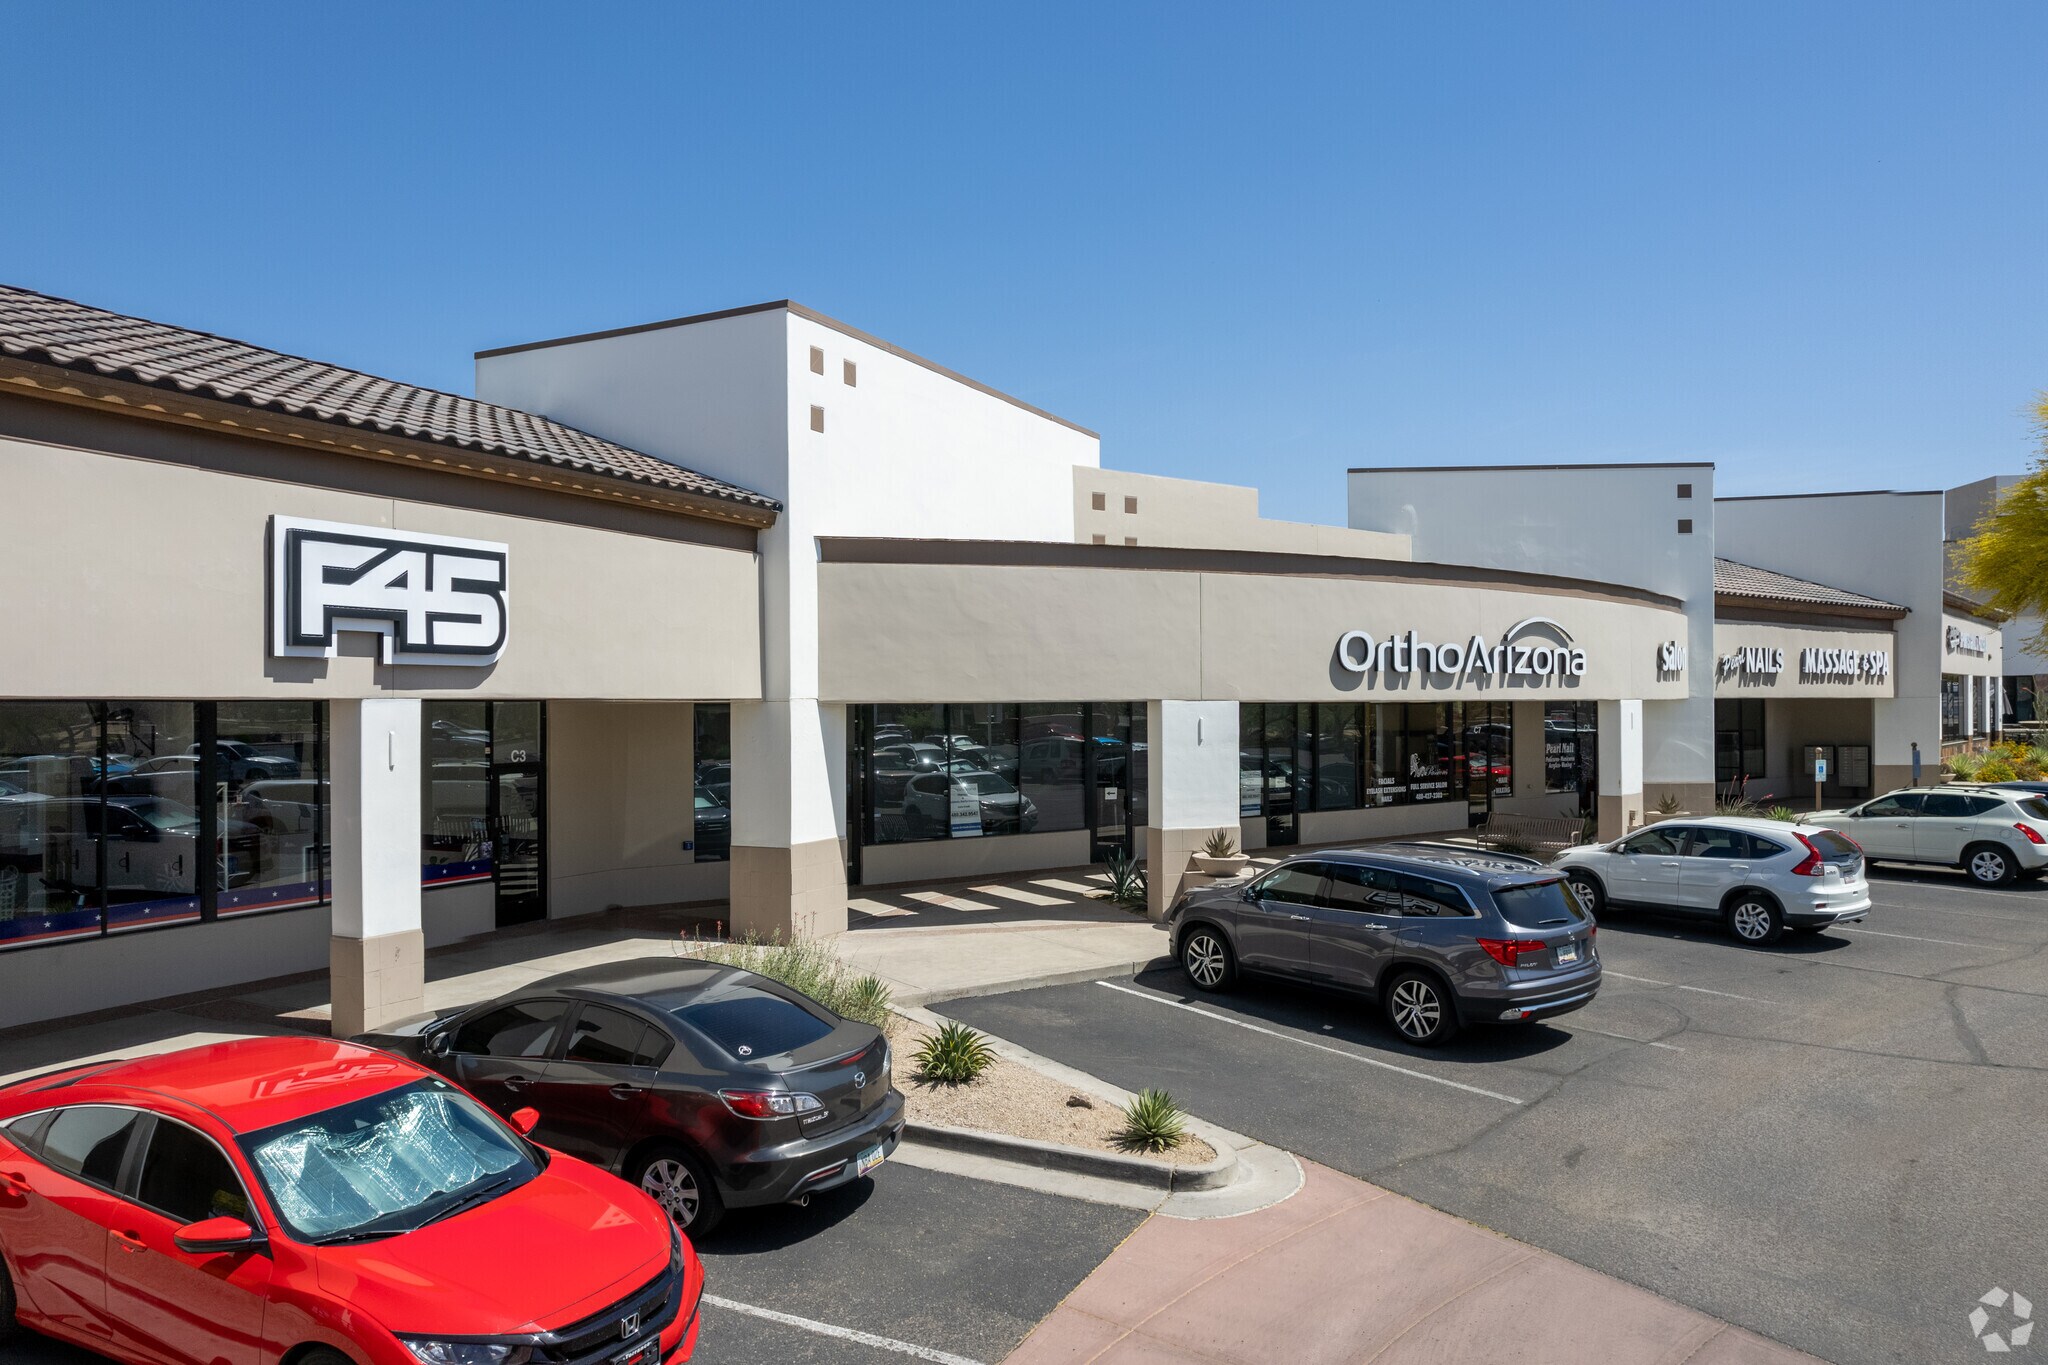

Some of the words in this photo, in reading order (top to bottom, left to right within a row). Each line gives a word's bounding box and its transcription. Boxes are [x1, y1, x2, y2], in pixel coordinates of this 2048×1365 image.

[287, 528, 507, 656] F45
[1338, 629, 1588, 676] OrthoArizona
[1746, 647, 1785, 673] NAILS
[1805, 647, 1860, 675] MASSAGE
[1862, 653, 1870, 671] &
[1869, 650, 1889, 676] SPA
[511, 749, 526, 762] C3
